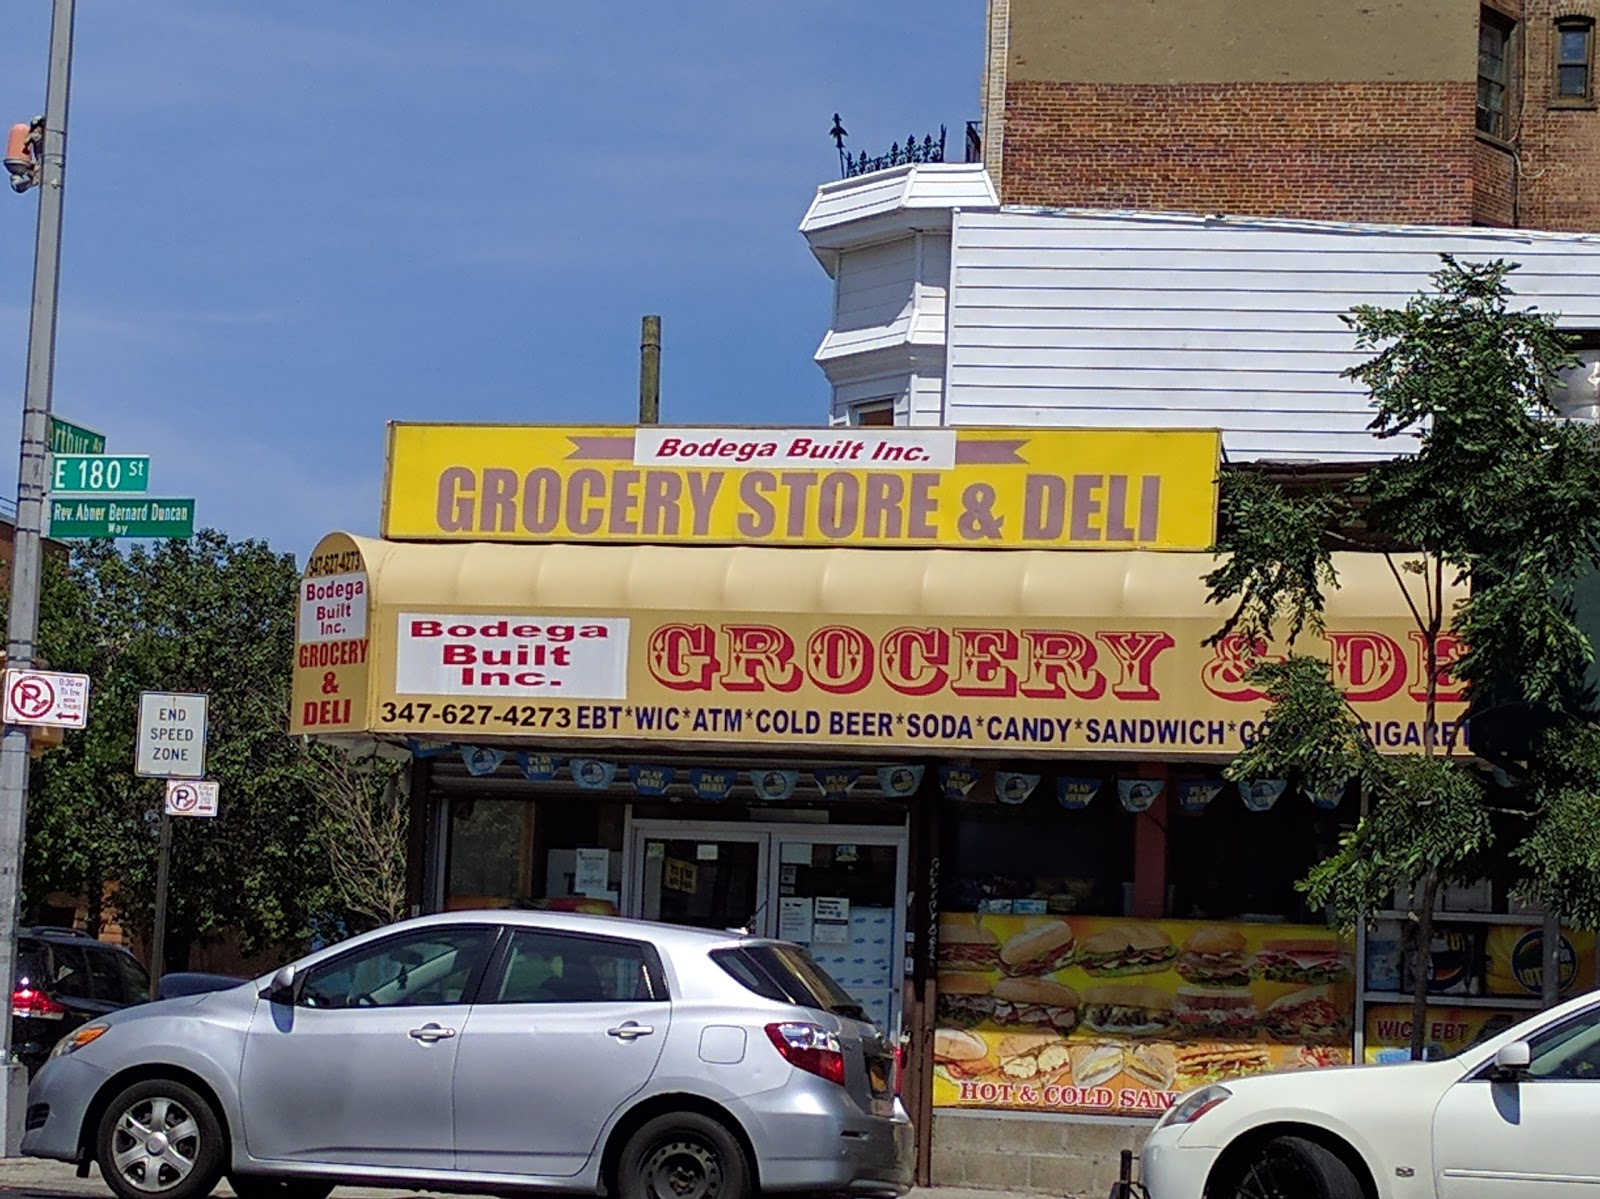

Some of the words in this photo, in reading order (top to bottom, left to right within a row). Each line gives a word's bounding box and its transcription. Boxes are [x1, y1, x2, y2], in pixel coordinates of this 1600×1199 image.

[54, 424, 90, 454] rthur
[656, 437, 778, 462] Bodega
[786, 438, 865, 461] Built
[872, 441, 930, 462] Inc.
[54, 459, 66, 488] E
[78, 460, 121, 489] 180
[129, 461, 144, 477] St
[53, 503, 74, 521] Rev.
[76, 503, 105, 521] Abner
[109, 503, 148, 522] Bernard
[151, 504, 188, 522] Duncan
[436, 466, 726, 536] GROCERY
[736, 470, 941, 540] STORE
[957, 483, 1004, 540] &
[1022, 473, 1160, 543] DELI
[107, 523, 128, 536] Way
[306, 578, 364, 602] Bodega
[316, 603, 352, 621] Built
[320, 621, 346, 636] Inc.
[410, 620, 609, 642] Bodega
[299, 638, 369, 668] GROCERY
[442, 644, 571, 666] Built
[647, 622, 1175, 701] GROCERY
[321, 671, 340, 694] &
[461, 668, 562, 687] Inc.
[159, 708, 186, 722] END
[302, 698, 351, 726] DELI
[381, 702, 571, 728] 347-627-4273
[577, 705, 622, 730] EBT
[635, 706, 680, 731] WIC
[692, 707, 742, 733] ATM
[906, 713, 973, 740] SODA
[987, 716, 1073, 743] CANDY
[150, 727, 194, 742] SPEED
[152, 748, 189, 761] ZONE
[1377, 1020, 1413, 1039] WIC
[1430, 1022, 1469, 1041] EBT
[960, 1082, 1015, 1102] HOT
[1019, 1085, 1037, 1104] &
[1043, 1086, 1114, 1107] COLD
